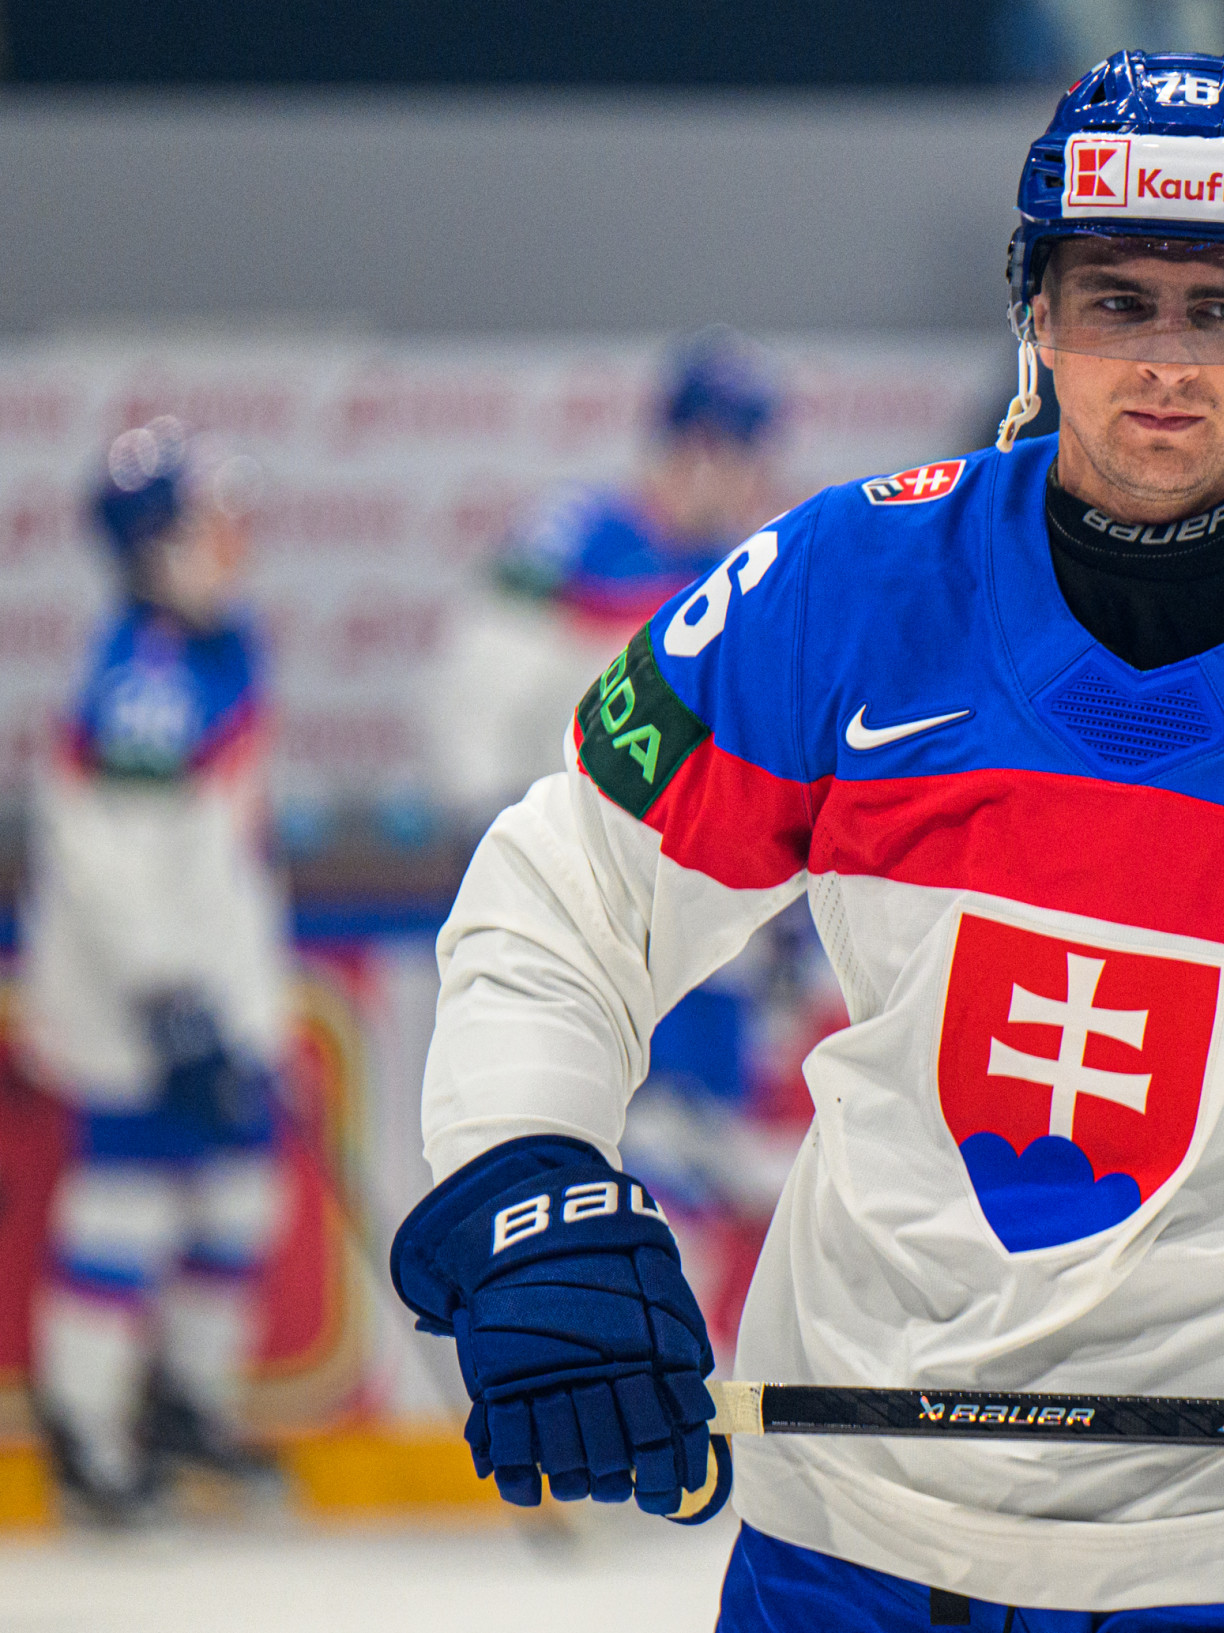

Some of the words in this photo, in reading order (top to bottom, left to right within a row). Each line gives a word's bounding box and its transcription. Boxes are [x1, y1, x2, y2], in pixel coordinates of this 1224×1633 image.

[1147, 76, 1220, 105] 76
[663, 529, 779, 658] 6
[600, 645, 662, 784] ODA
[949, 1404, 1095, 1426] BAUER
